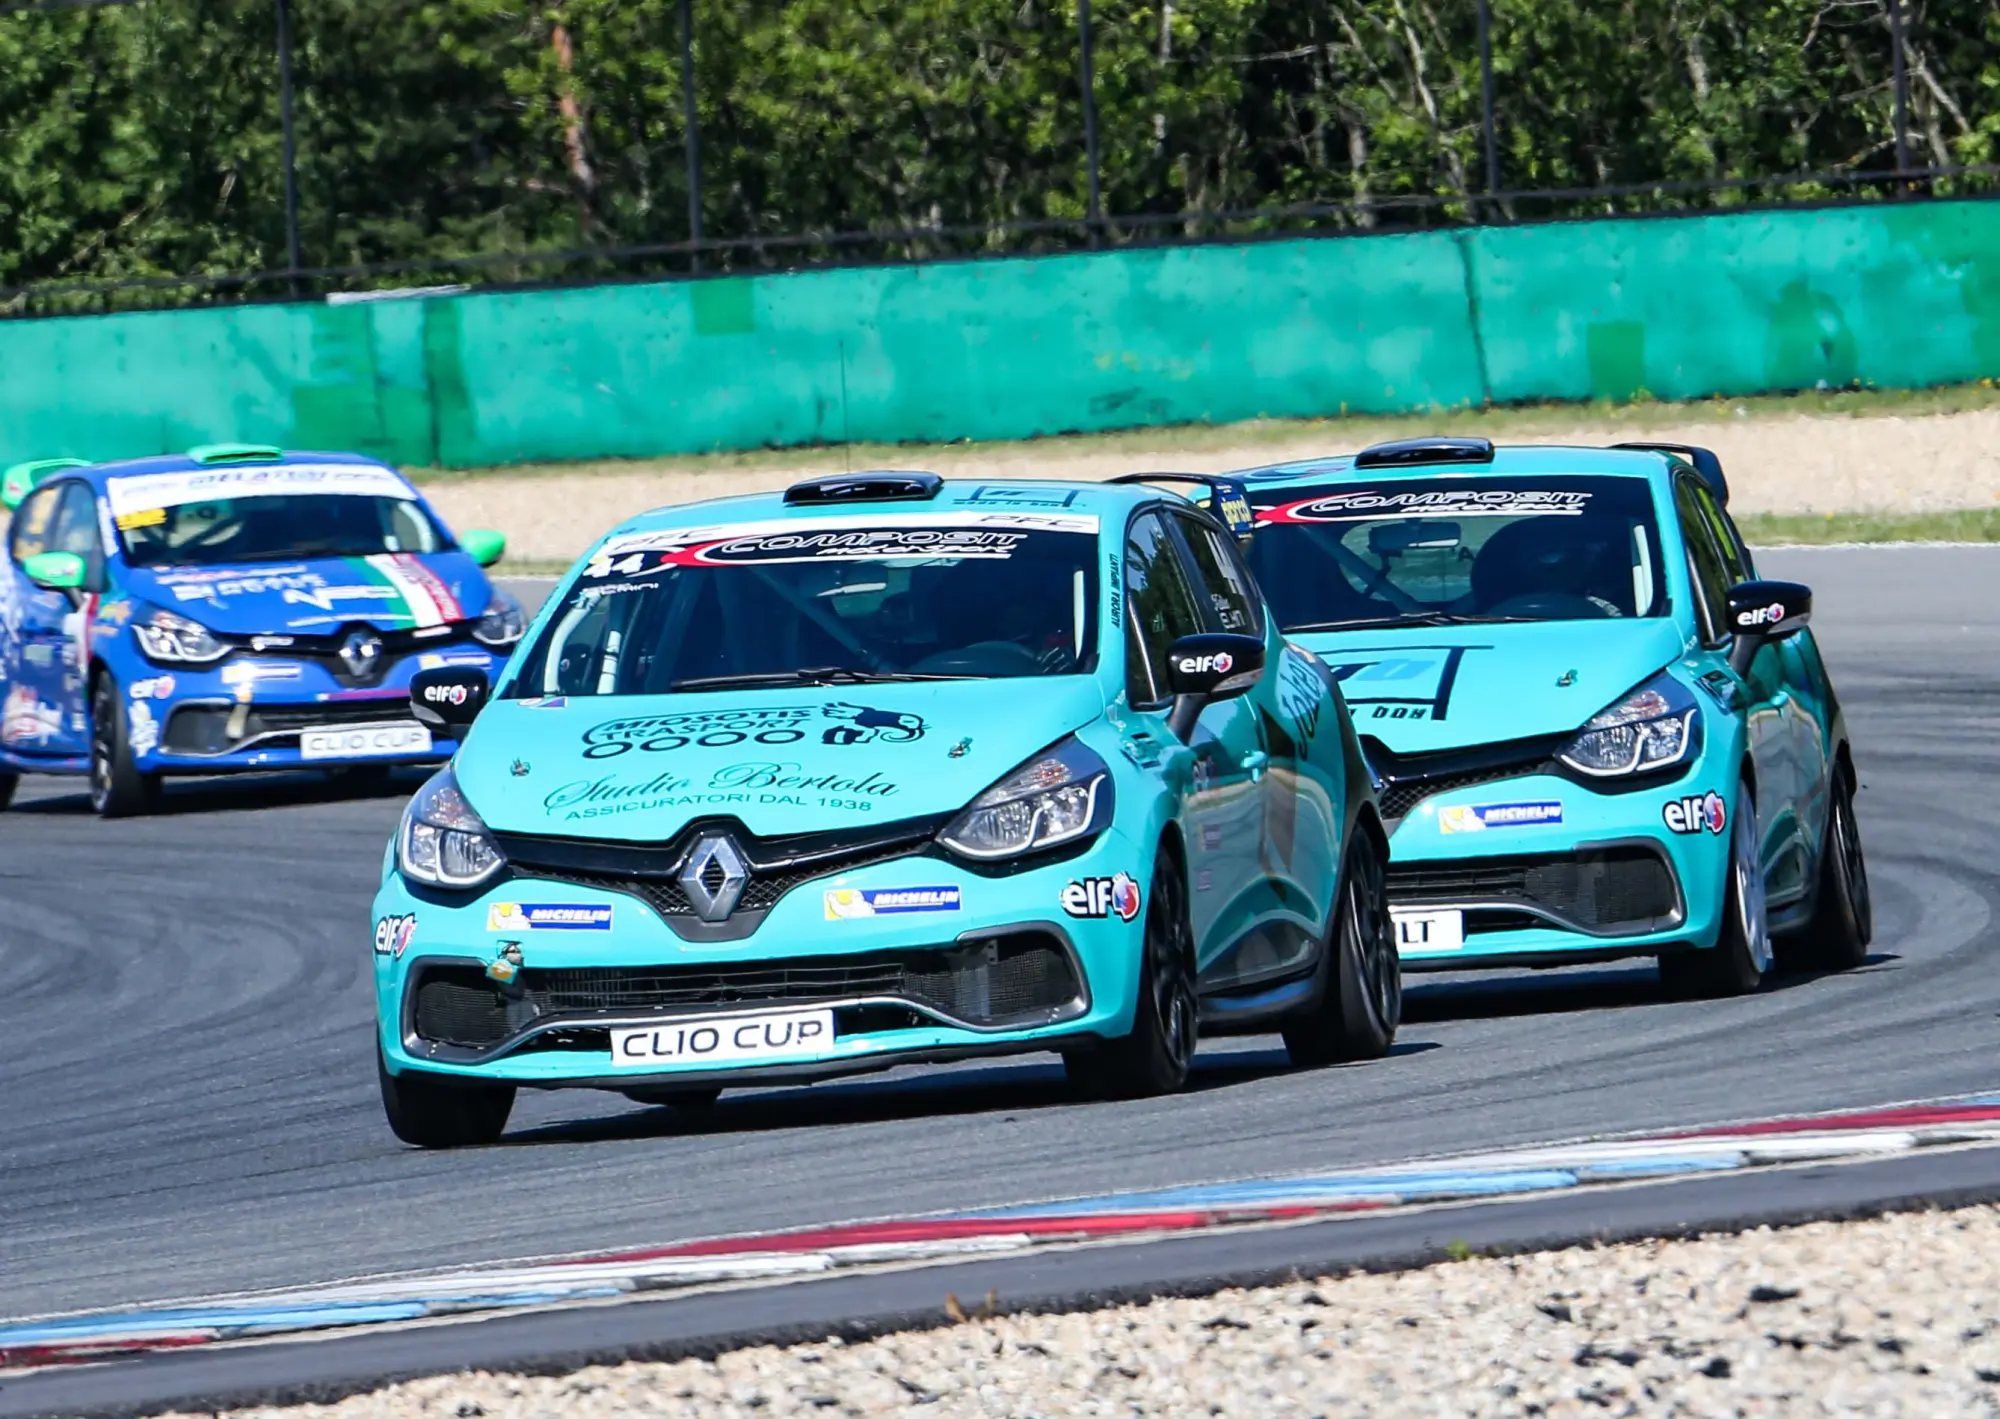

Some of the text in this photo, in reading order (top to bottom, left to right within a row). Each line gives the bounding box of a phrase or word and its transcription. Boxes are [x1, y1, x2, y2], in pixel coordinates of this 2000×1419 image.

[1311, 491, 1593, 512] COMPOSIT
[722, 531, 1028, 553] COMPOSIT
[583, 553, 645, 578] 44
[1737, 607, 1767, 626] elf
[1179, 656, 1213, 673] elf
[424, 685, 451, 702] elf
[600, 719, 811, 740] TRASPORT
[604, 710, 811, 731] MIOSOTIS
[310, 731, 424, 751] CLIO CUP
[708, 761, 900, 797] Bertola
[565, 793, 873, 821] ASSICURATORI DAL 1938
[1484, 804, 1561, 821] MICHELIN
[1663, 800, 1704, 832] elf
[873, 891, 959, 907] MICHELIN
[1064, 880, 1112, 917] elf
[530, 909, 610, 922] MICHELIN
[622, 1019, 824, 1058] CLIO CUP
